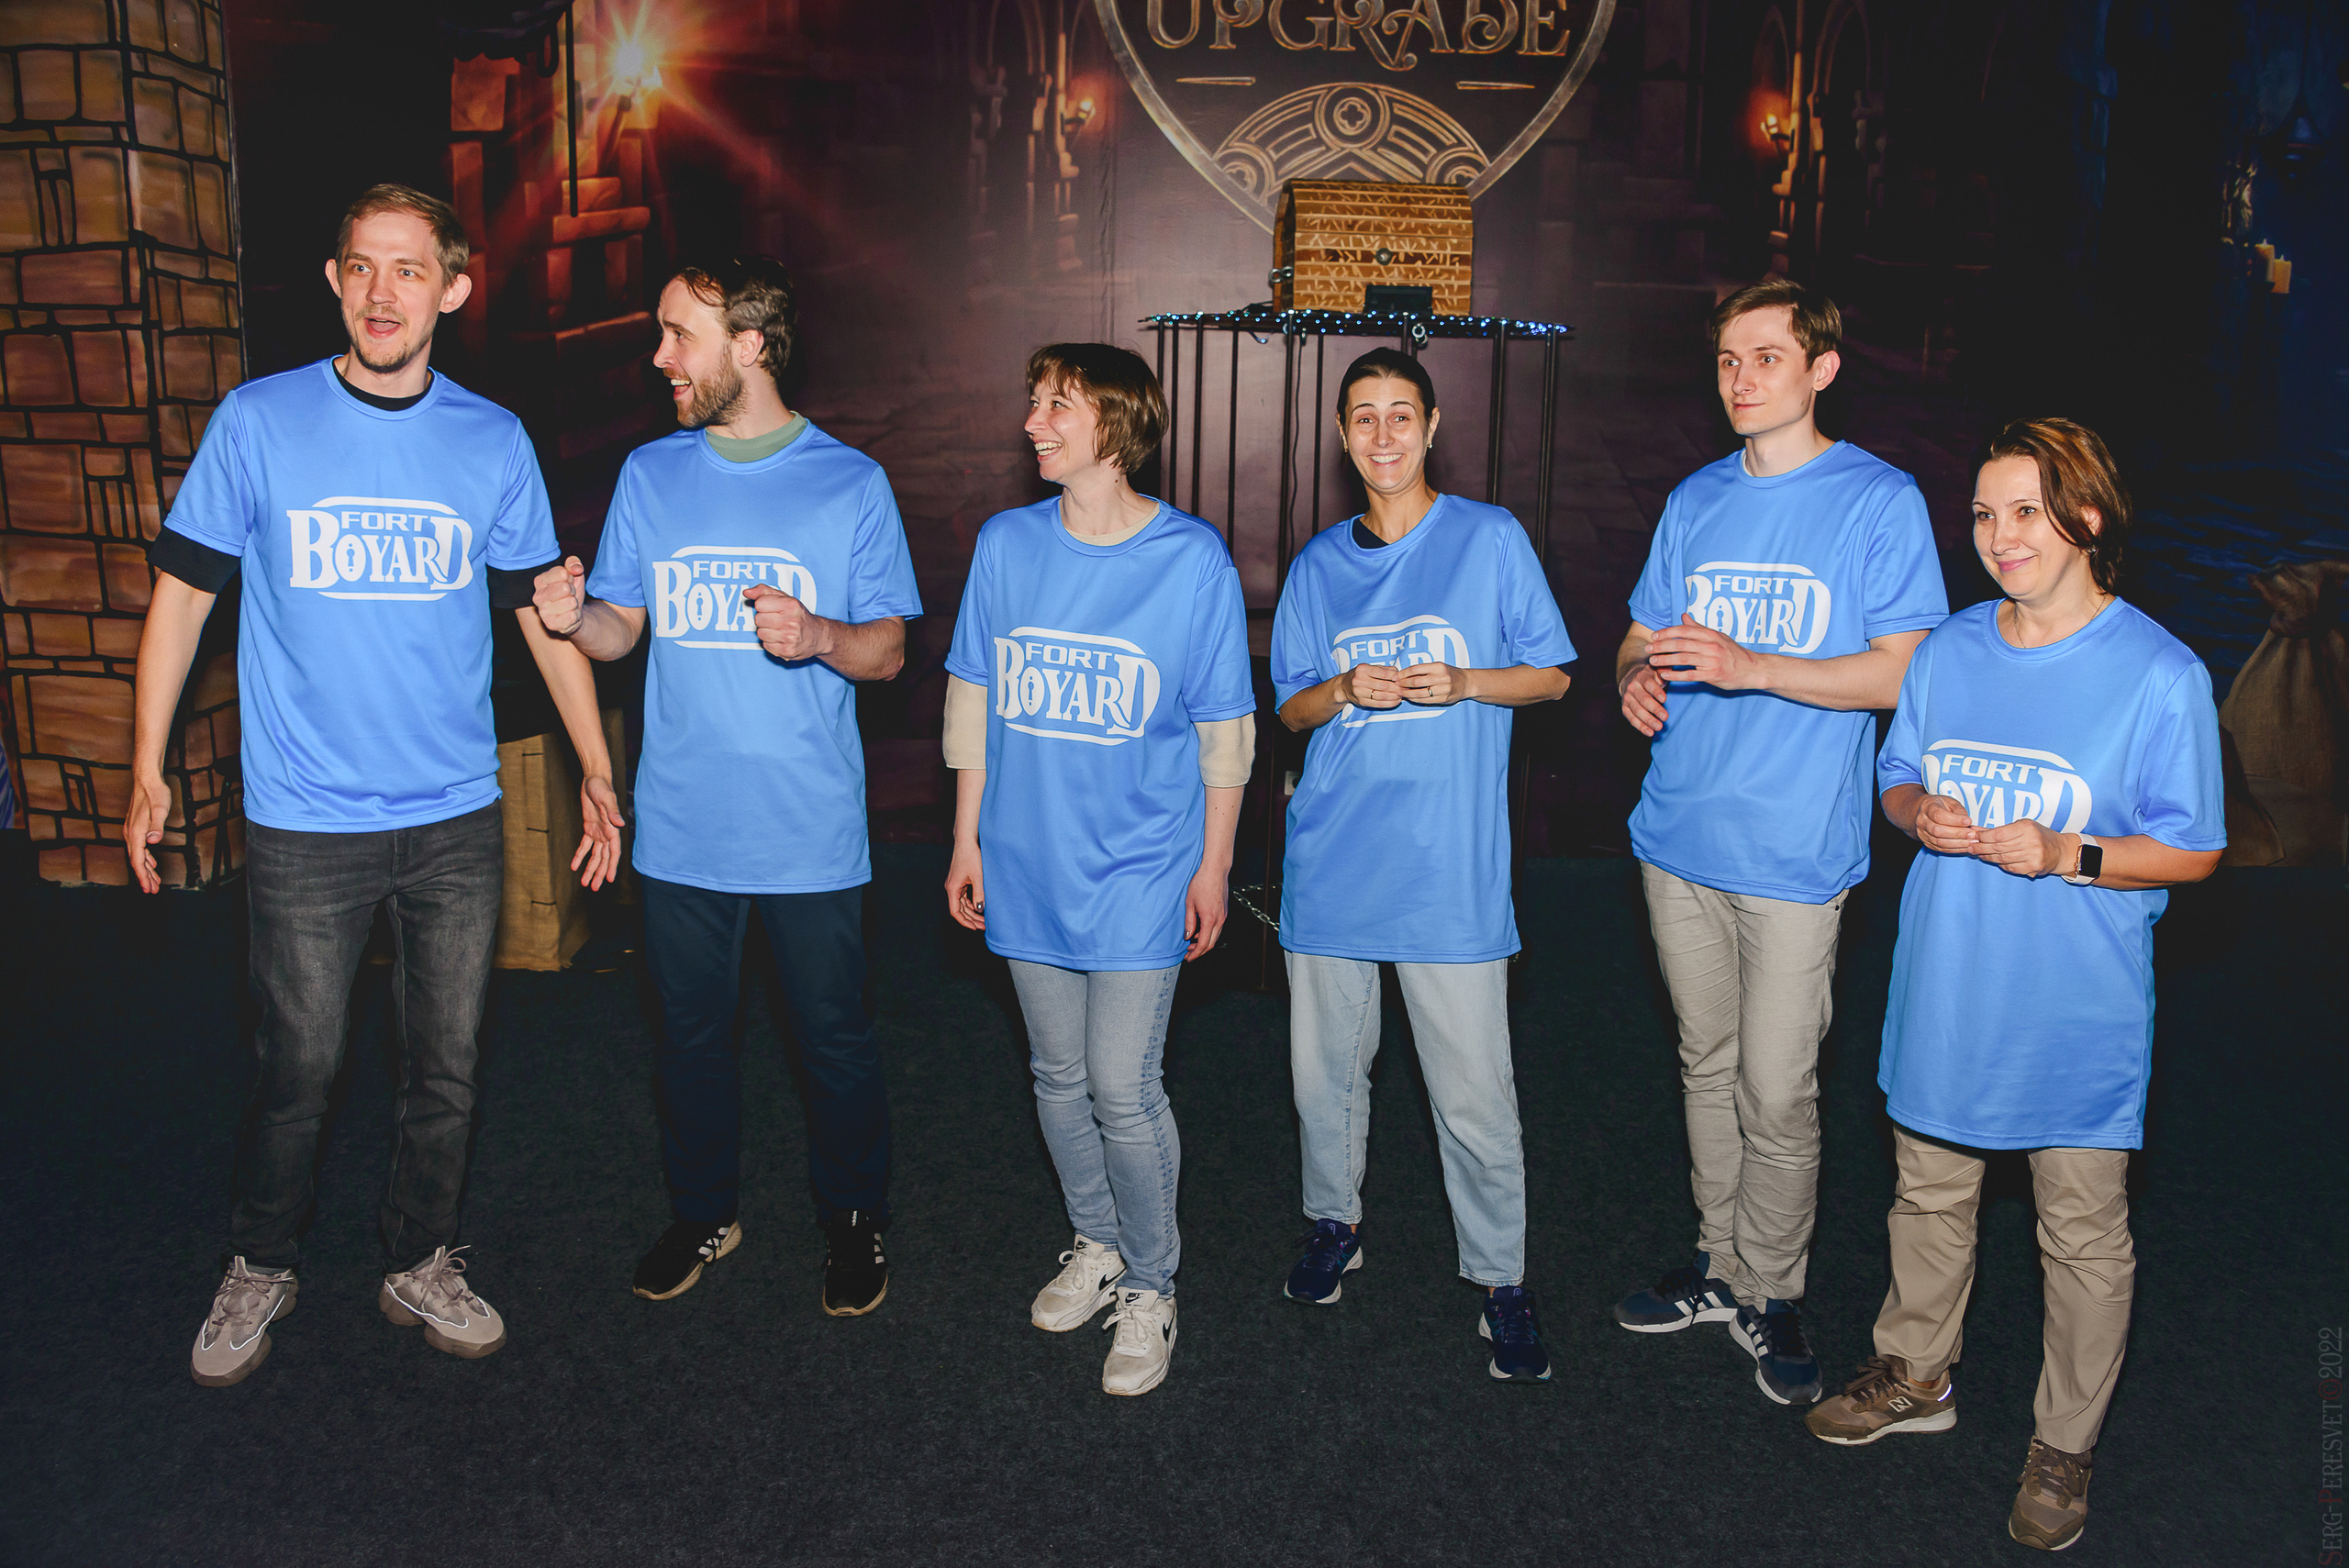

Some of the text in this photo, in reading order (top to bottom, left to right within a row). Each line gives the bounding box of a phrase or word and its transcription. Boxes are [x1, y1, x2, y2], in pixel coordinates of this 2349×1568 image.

[1146, 0, 1571, 71] UPGRADE
[341, 511, 429, 532] FORT
[286, 509, 473, 591] BOYARD
[693, 560, 772, 580] FORT
[1714, 574, 1789, 595] FORT
[652, 561, 818, 638] BOYAD
[1025, 642, 1112, 671] FORT
[1350, 629, 1421, 660] FORT
[994, 637, 1161, 739] BOYARD
[1942, 753, 2037, 784] FORT
